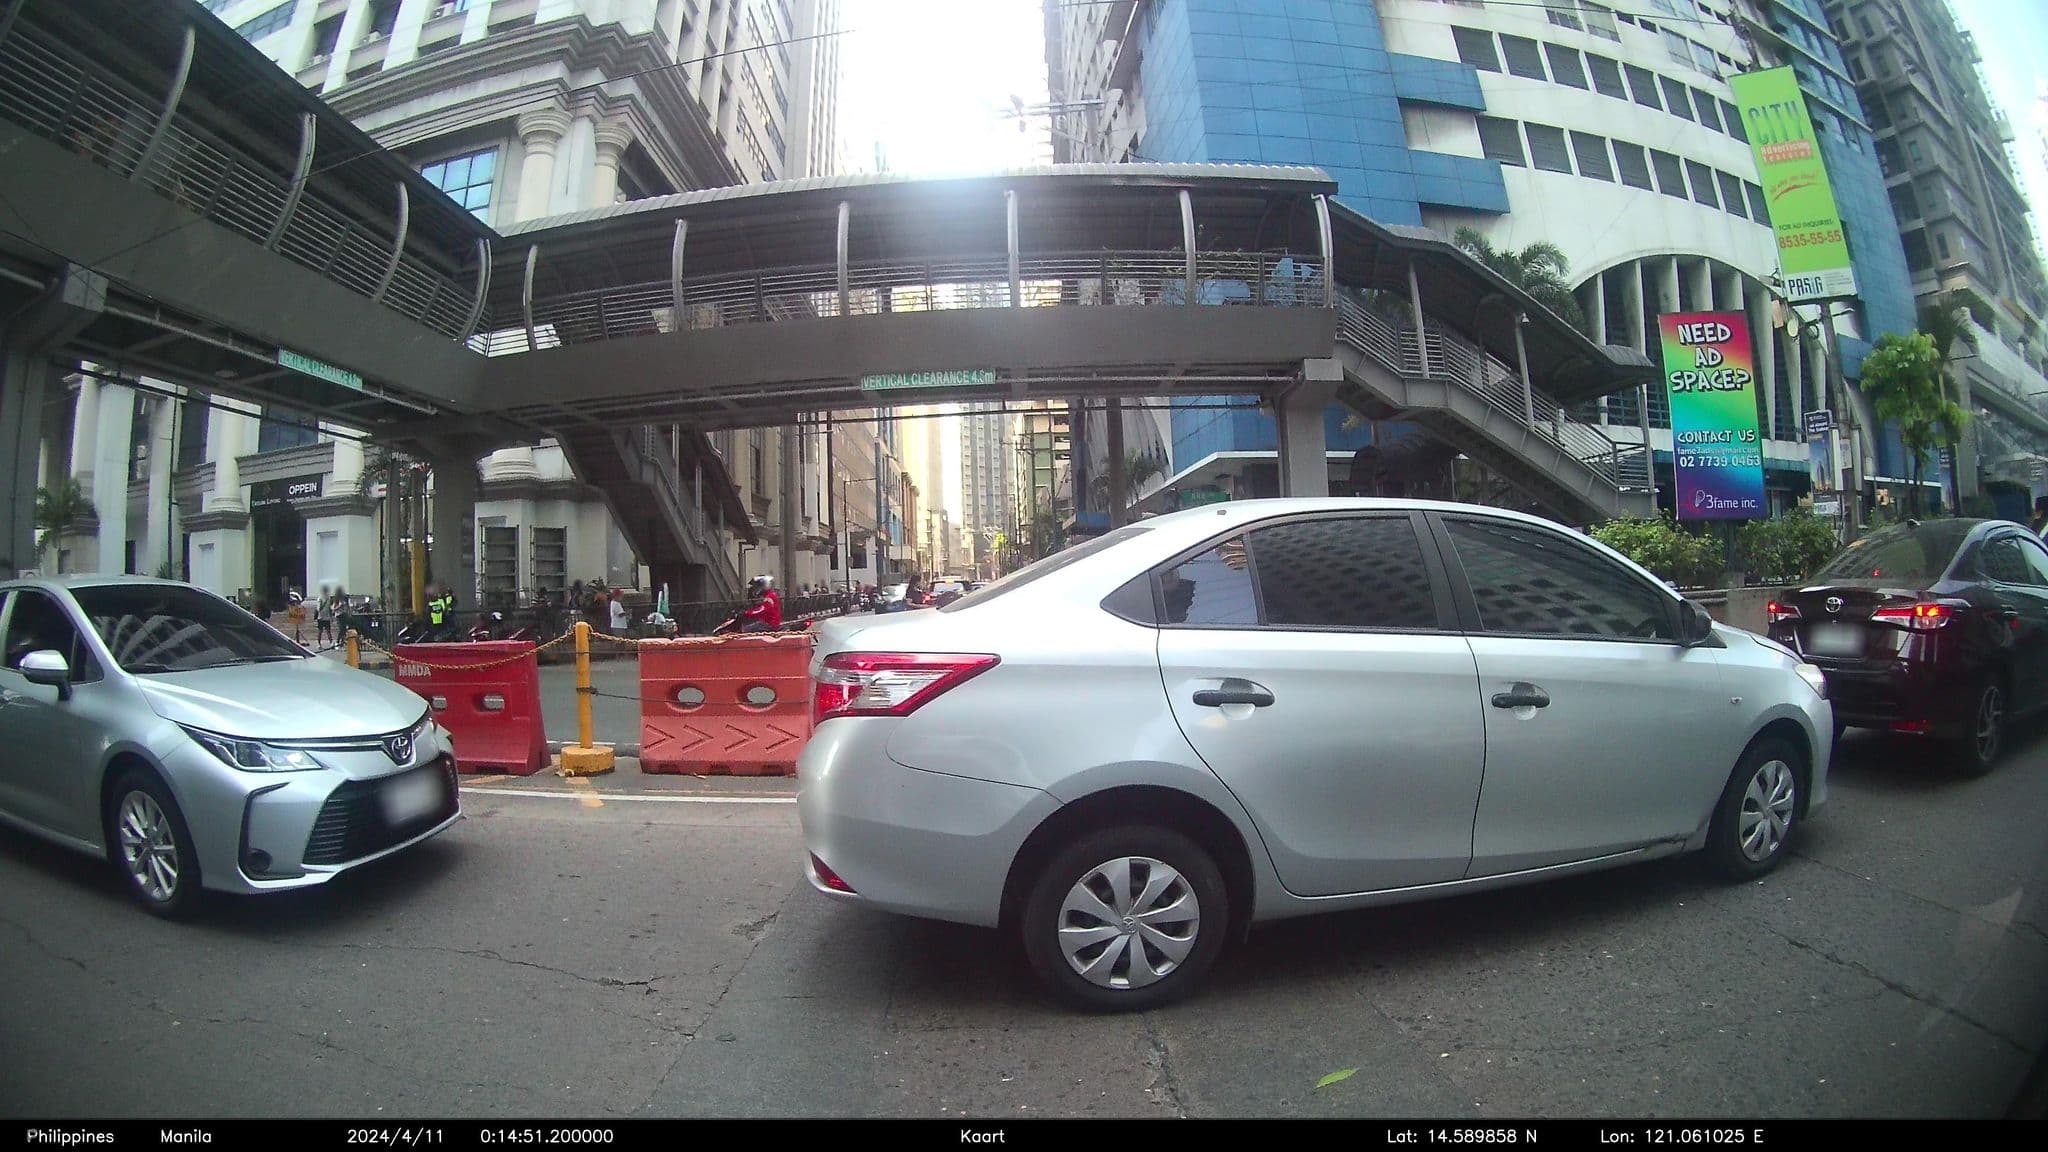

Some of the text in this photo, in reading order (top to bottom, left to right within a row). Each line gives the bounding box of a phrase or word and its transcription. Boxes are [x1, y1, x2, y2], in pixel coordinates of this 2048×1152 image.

[1748, 101, 1804, 144] CITY
[1779, 229, 1841, 249] 8535-55-55
[1677, 322, 1732, 346] NEED
[1694, 346, 1723, 367] AD
[280, 350, 311, 372] VERTICAL
[312, 360, 349, 383] CLEARANCE
[863, 374, 909, 388] VERTICAL
[911, 370, 969, 386] CLEARANCE
[1669, 368, 1751, 393] SPACE?
[1677, 429, 1755, 444] CONTACT US
[1680, 455, 1760, 467] 02 7739 0463
[288, 482, 317, 495] OPPEIN
[1706, 494, 1758, 509] 3fame inc.
[398, 664, 432, 677] MMDA
